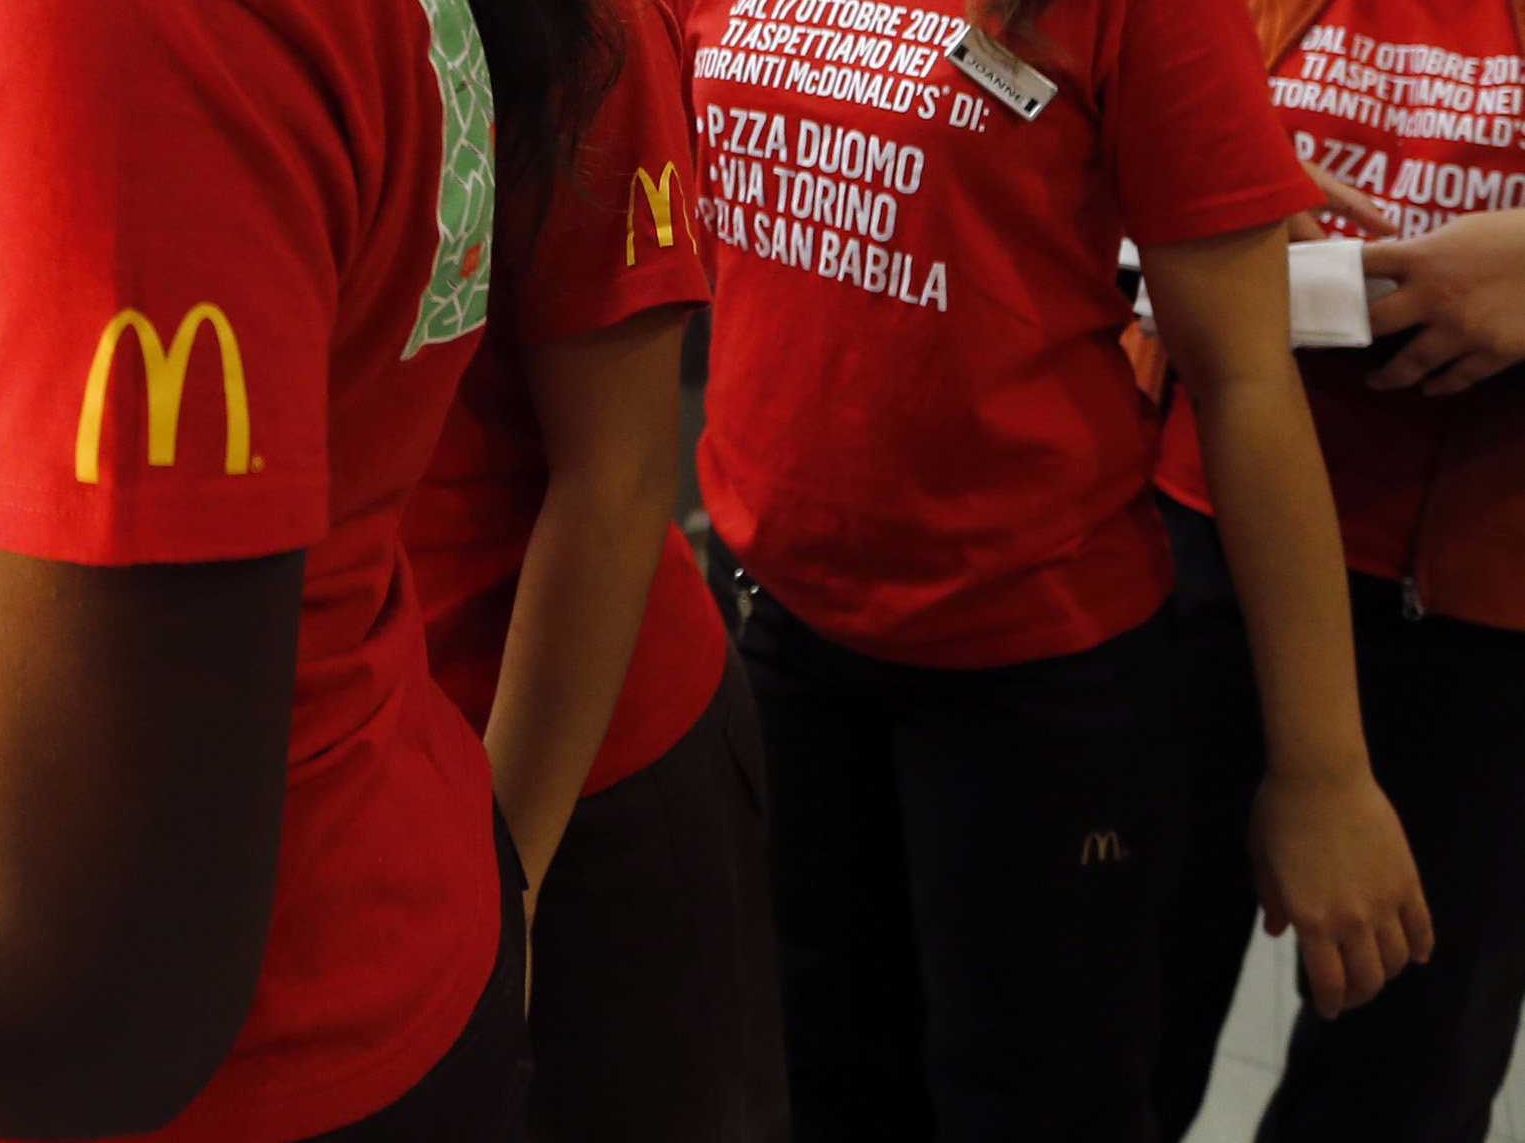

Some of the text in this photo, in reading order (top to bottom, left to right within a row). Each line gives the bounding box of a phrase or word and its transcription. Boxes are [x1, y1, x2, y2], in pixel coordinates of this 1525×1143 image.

[721, 17, 939, 78] TI ASPETTIAMO NEI
[1352, 33, 1375, 63] 17
[1480, 55, 1525, 85] 201
[949, 92, 989, 132] DI:
[1301, 53, 1328, 80] TI
[1475, 87, 1521, 115] NEI
[706, 104, 924, 194] P.ZZA DUOMO
[718, 154, 898, 242] VIA TORINO
[754, 212, 814, 271] SAN
[818, 229, 948, 312] BABILA
